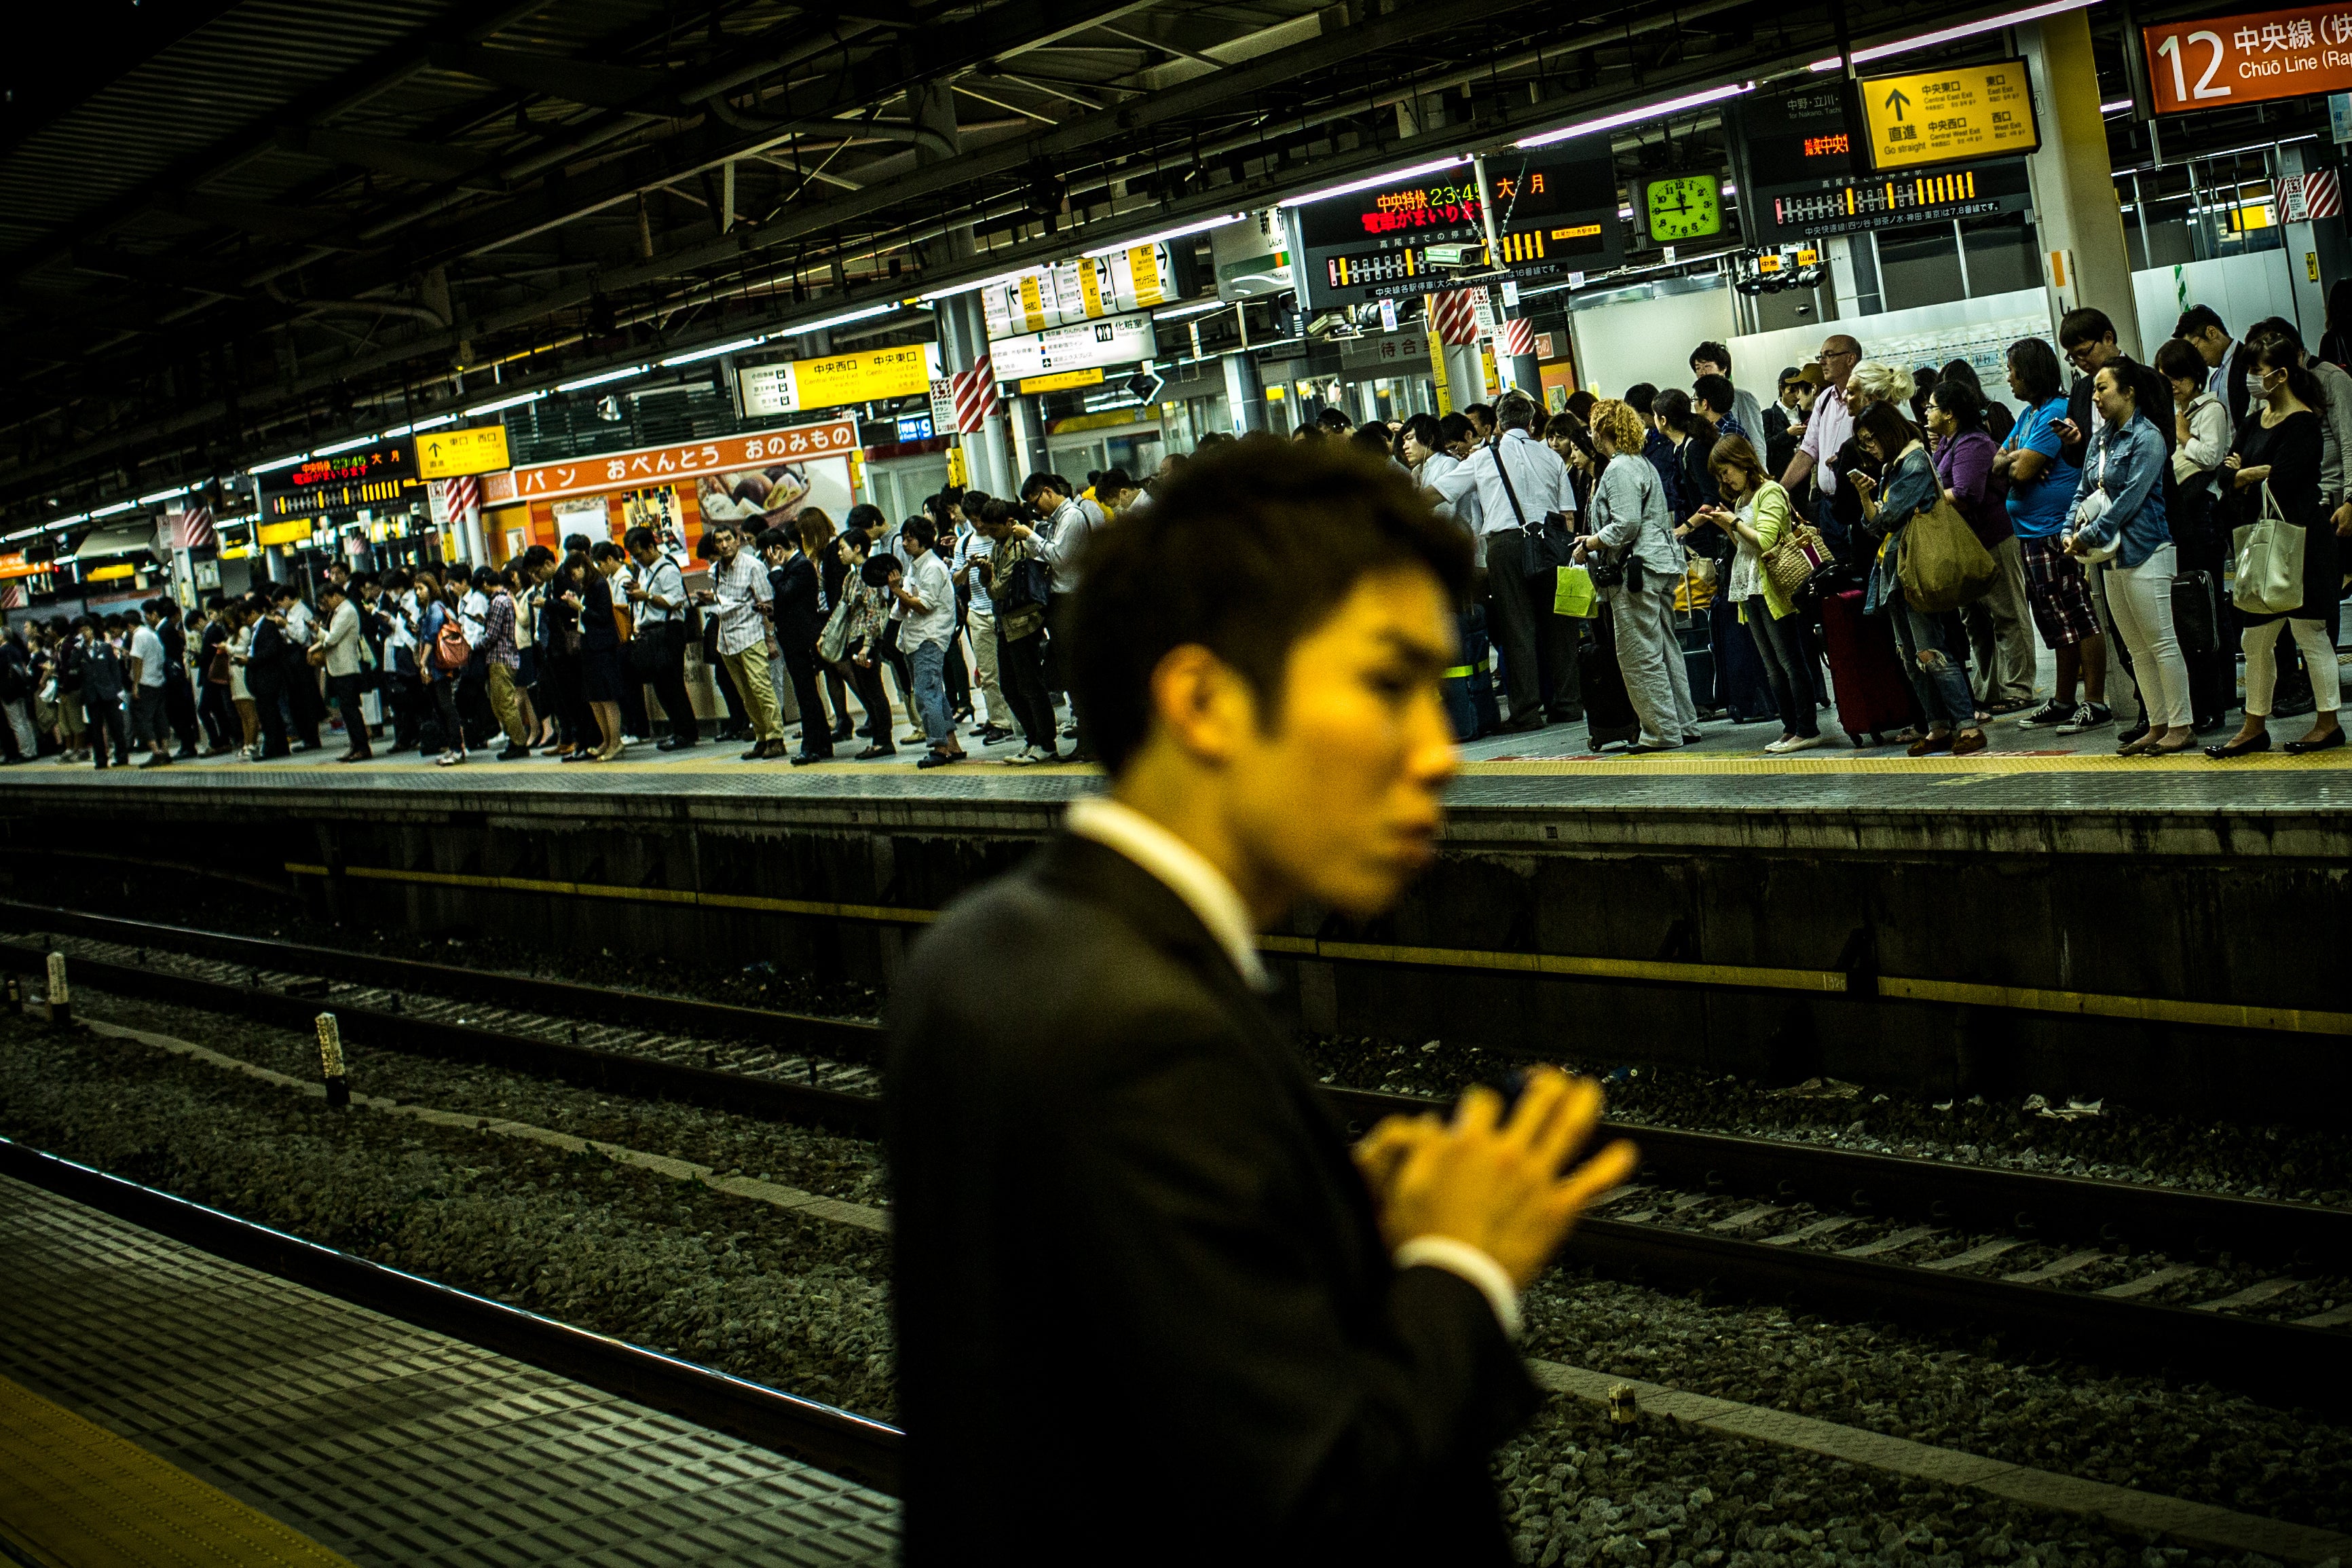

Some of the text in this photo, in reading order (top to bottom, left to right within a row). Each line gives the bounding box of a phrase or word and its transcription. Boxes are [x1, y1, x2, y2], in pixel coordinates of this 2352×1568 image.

[2157, 31, 2231, 101] 12
[2239, 50, 2352, 79] Chūō Line (Ra
[1922, 81, 1960, 95] 中央東口
[1985, 75, 2005, 87] 東口
[1928, 117, 1966, 132] 中央西口
[1992, 111, 2011, 124] 西口
[1888, 124, 1918, 143] 直進
[1884, 146, 1896, 155] Go
[1898, 142, 1926, 153] straight
[1666, 187, 1674, 195] 11
[1675, 181, 1685, 189] 12
[1377, 189, 1429, 214] 中央特快
[1658, 195, 1666, 204] 10
[1681, 226, 1688, 234] 6
[874, 351, 917, 367] 中央東口
[814, 360, 857, 375] 中央西口
[804, 377, 827, 386] Central
[524, 467, 576, 493] パン
[606, 447, 720, 481] おべんとう
[745, 425, 852, 460] おのみもの
